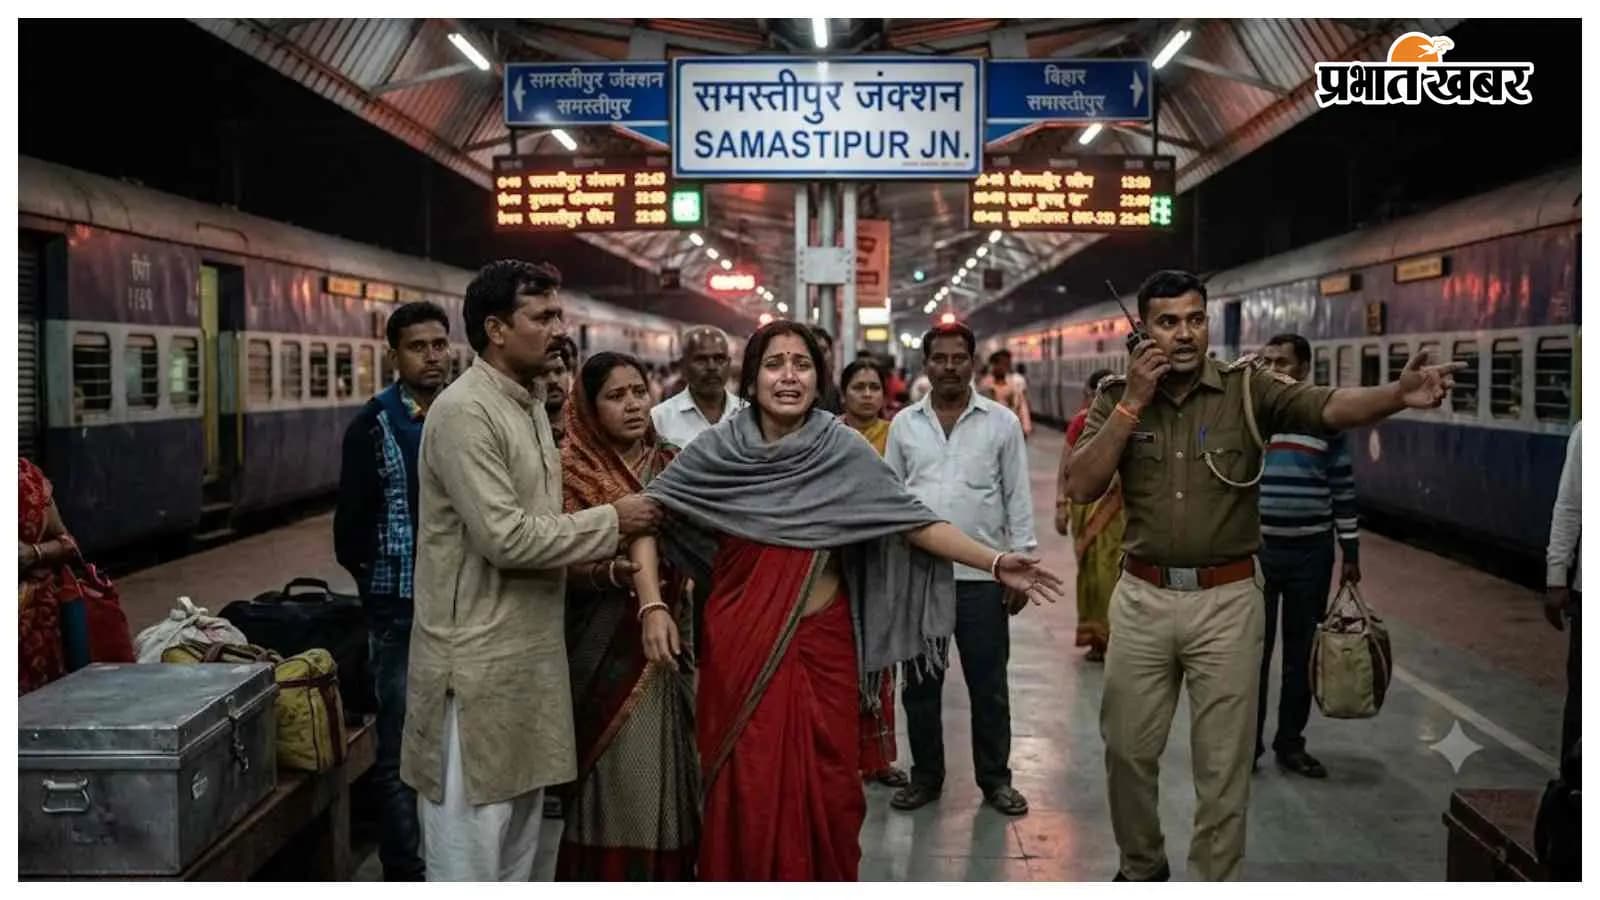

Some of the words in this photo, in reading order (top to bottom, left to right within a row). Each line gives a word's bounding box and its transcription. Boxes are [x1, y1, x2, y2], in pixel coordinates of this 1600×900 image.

[528, 67, 605, 94] समस्तीपुर
[556, 93, 633, 120] समस्तीपुर
[692, 68, 844, 125] समस्तीपुर
[854, 71, 964, 112] जंक्शन
[694, 130, 910, 159] SAMASTIPUR
[920, 130, 970, 159] JN.
